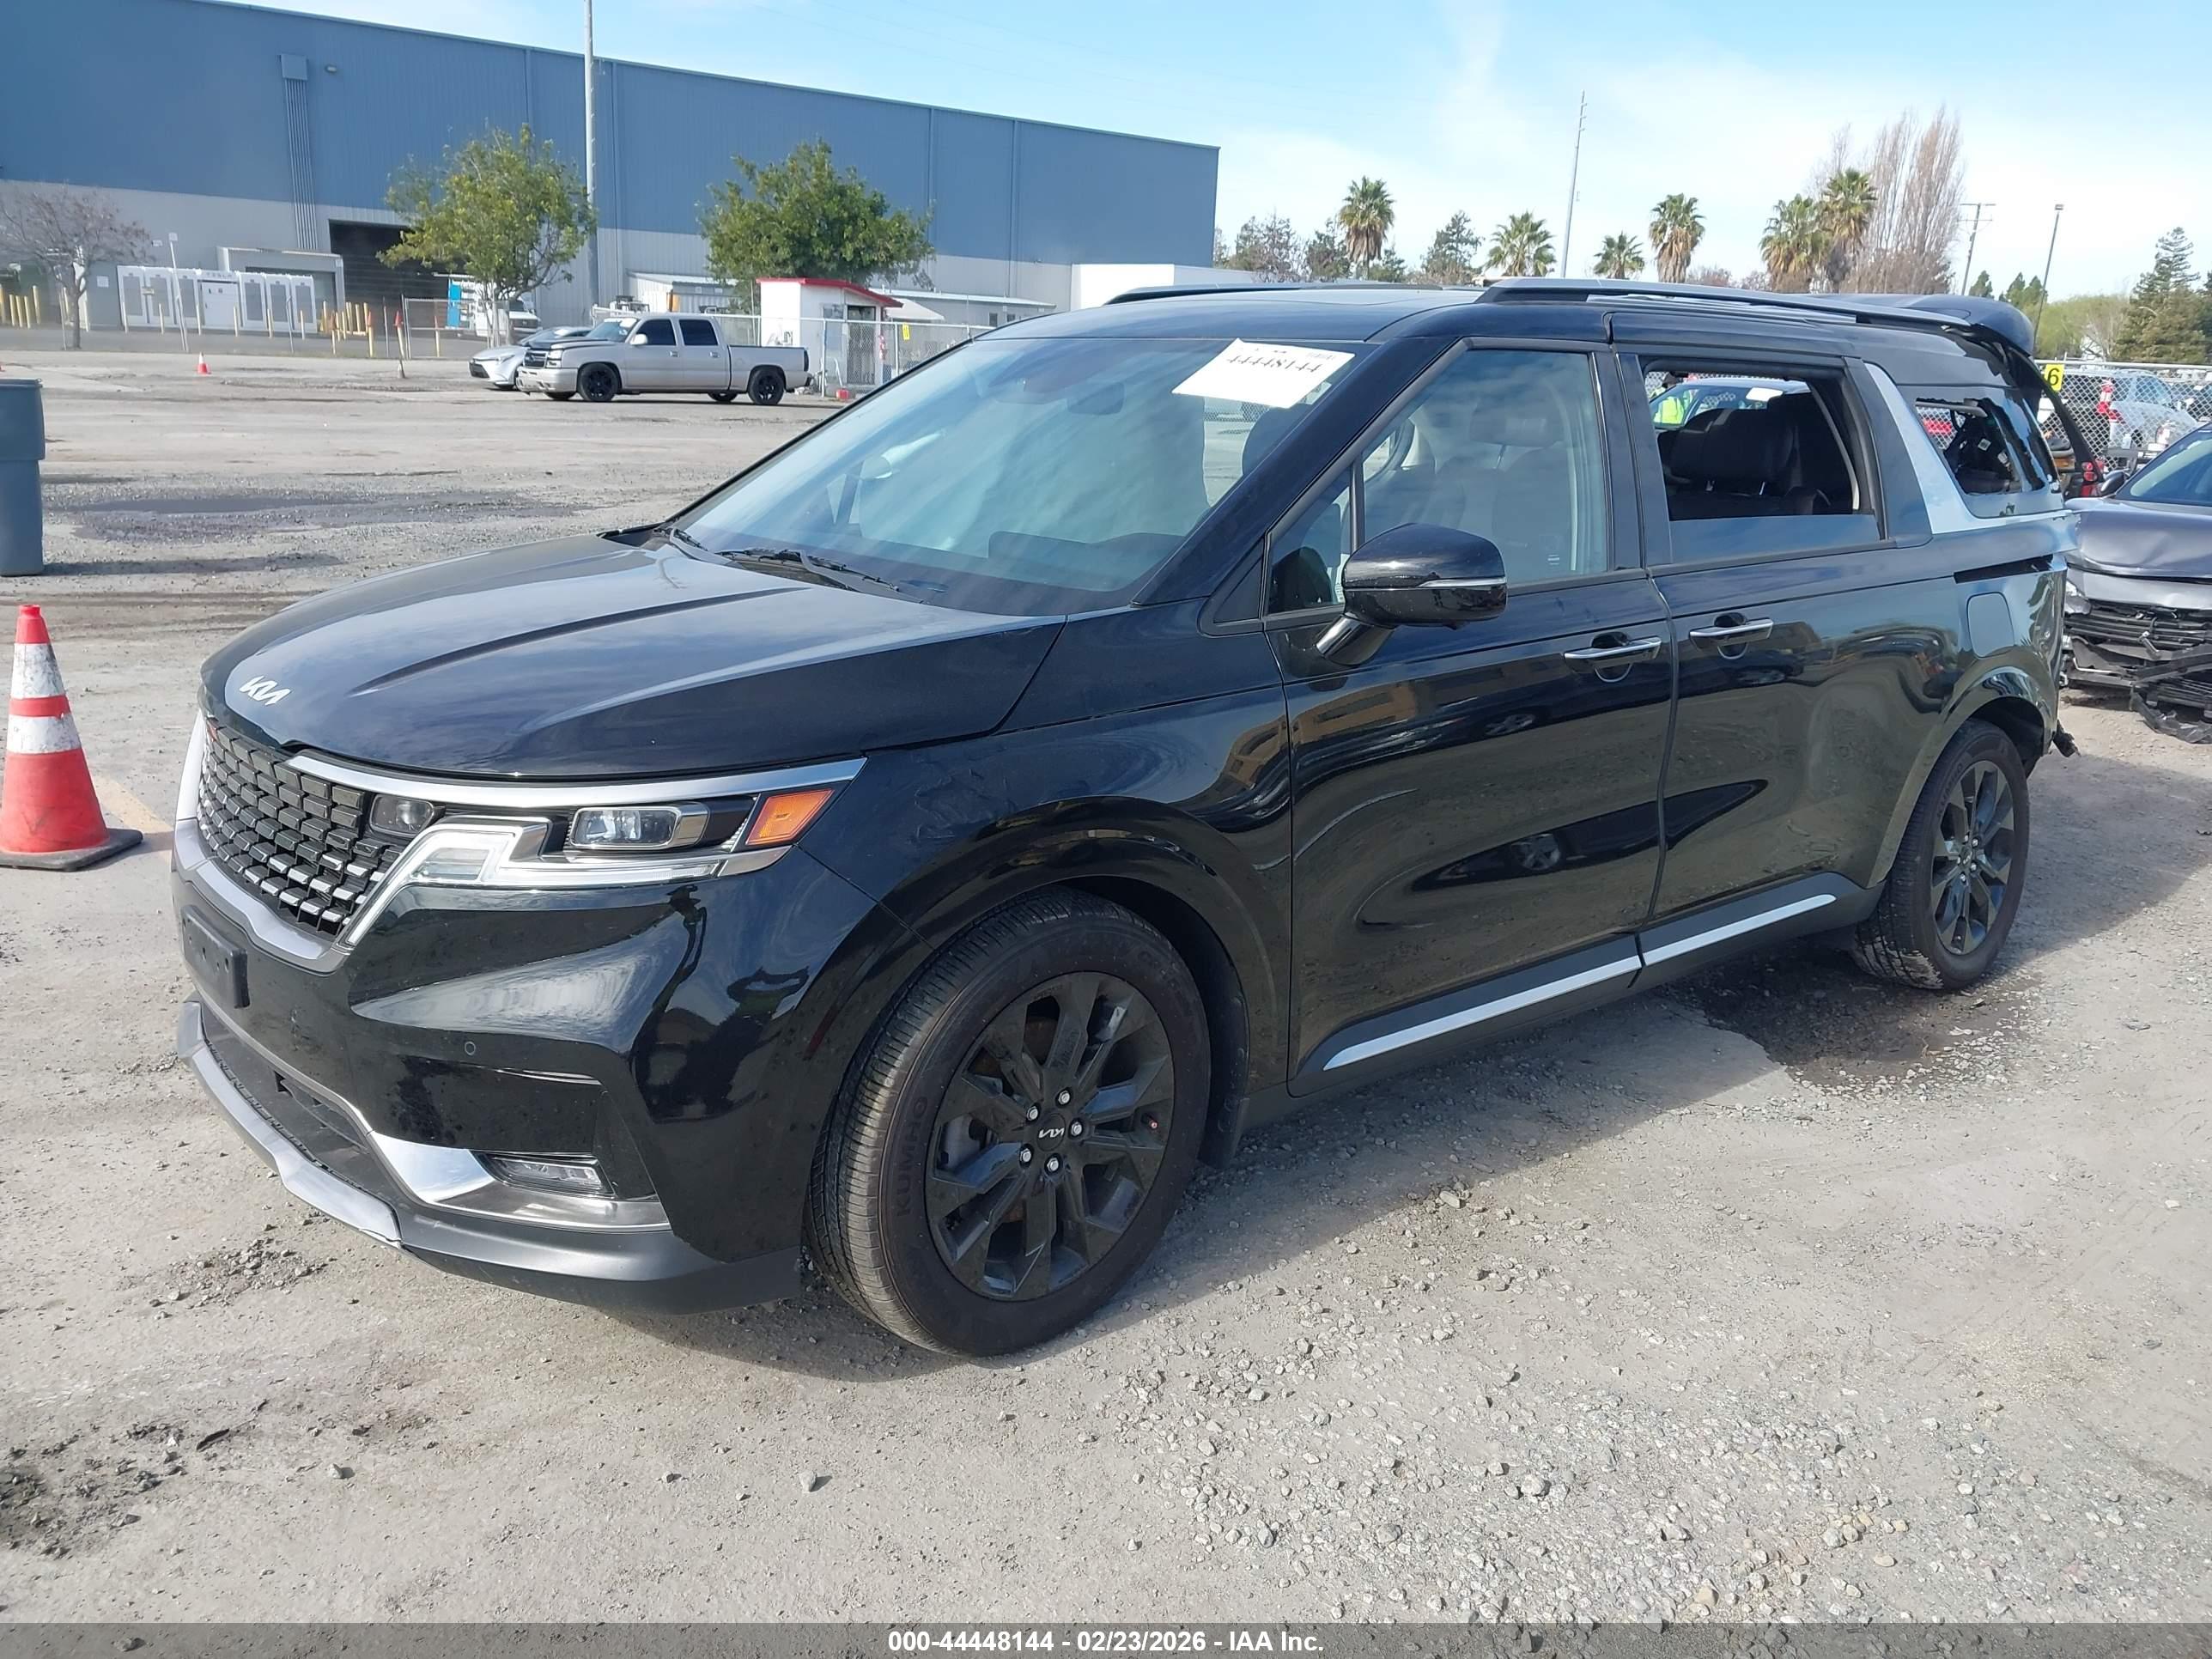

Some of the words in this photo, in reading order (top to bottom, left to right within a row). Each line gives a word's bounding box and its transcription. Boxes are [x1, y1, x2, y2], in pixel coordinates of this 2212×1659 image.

[1227, 355, 1322, 372] 44448144
[2047, 368, 2060, 386] 6
[239, 675, 291, 706] KIA
